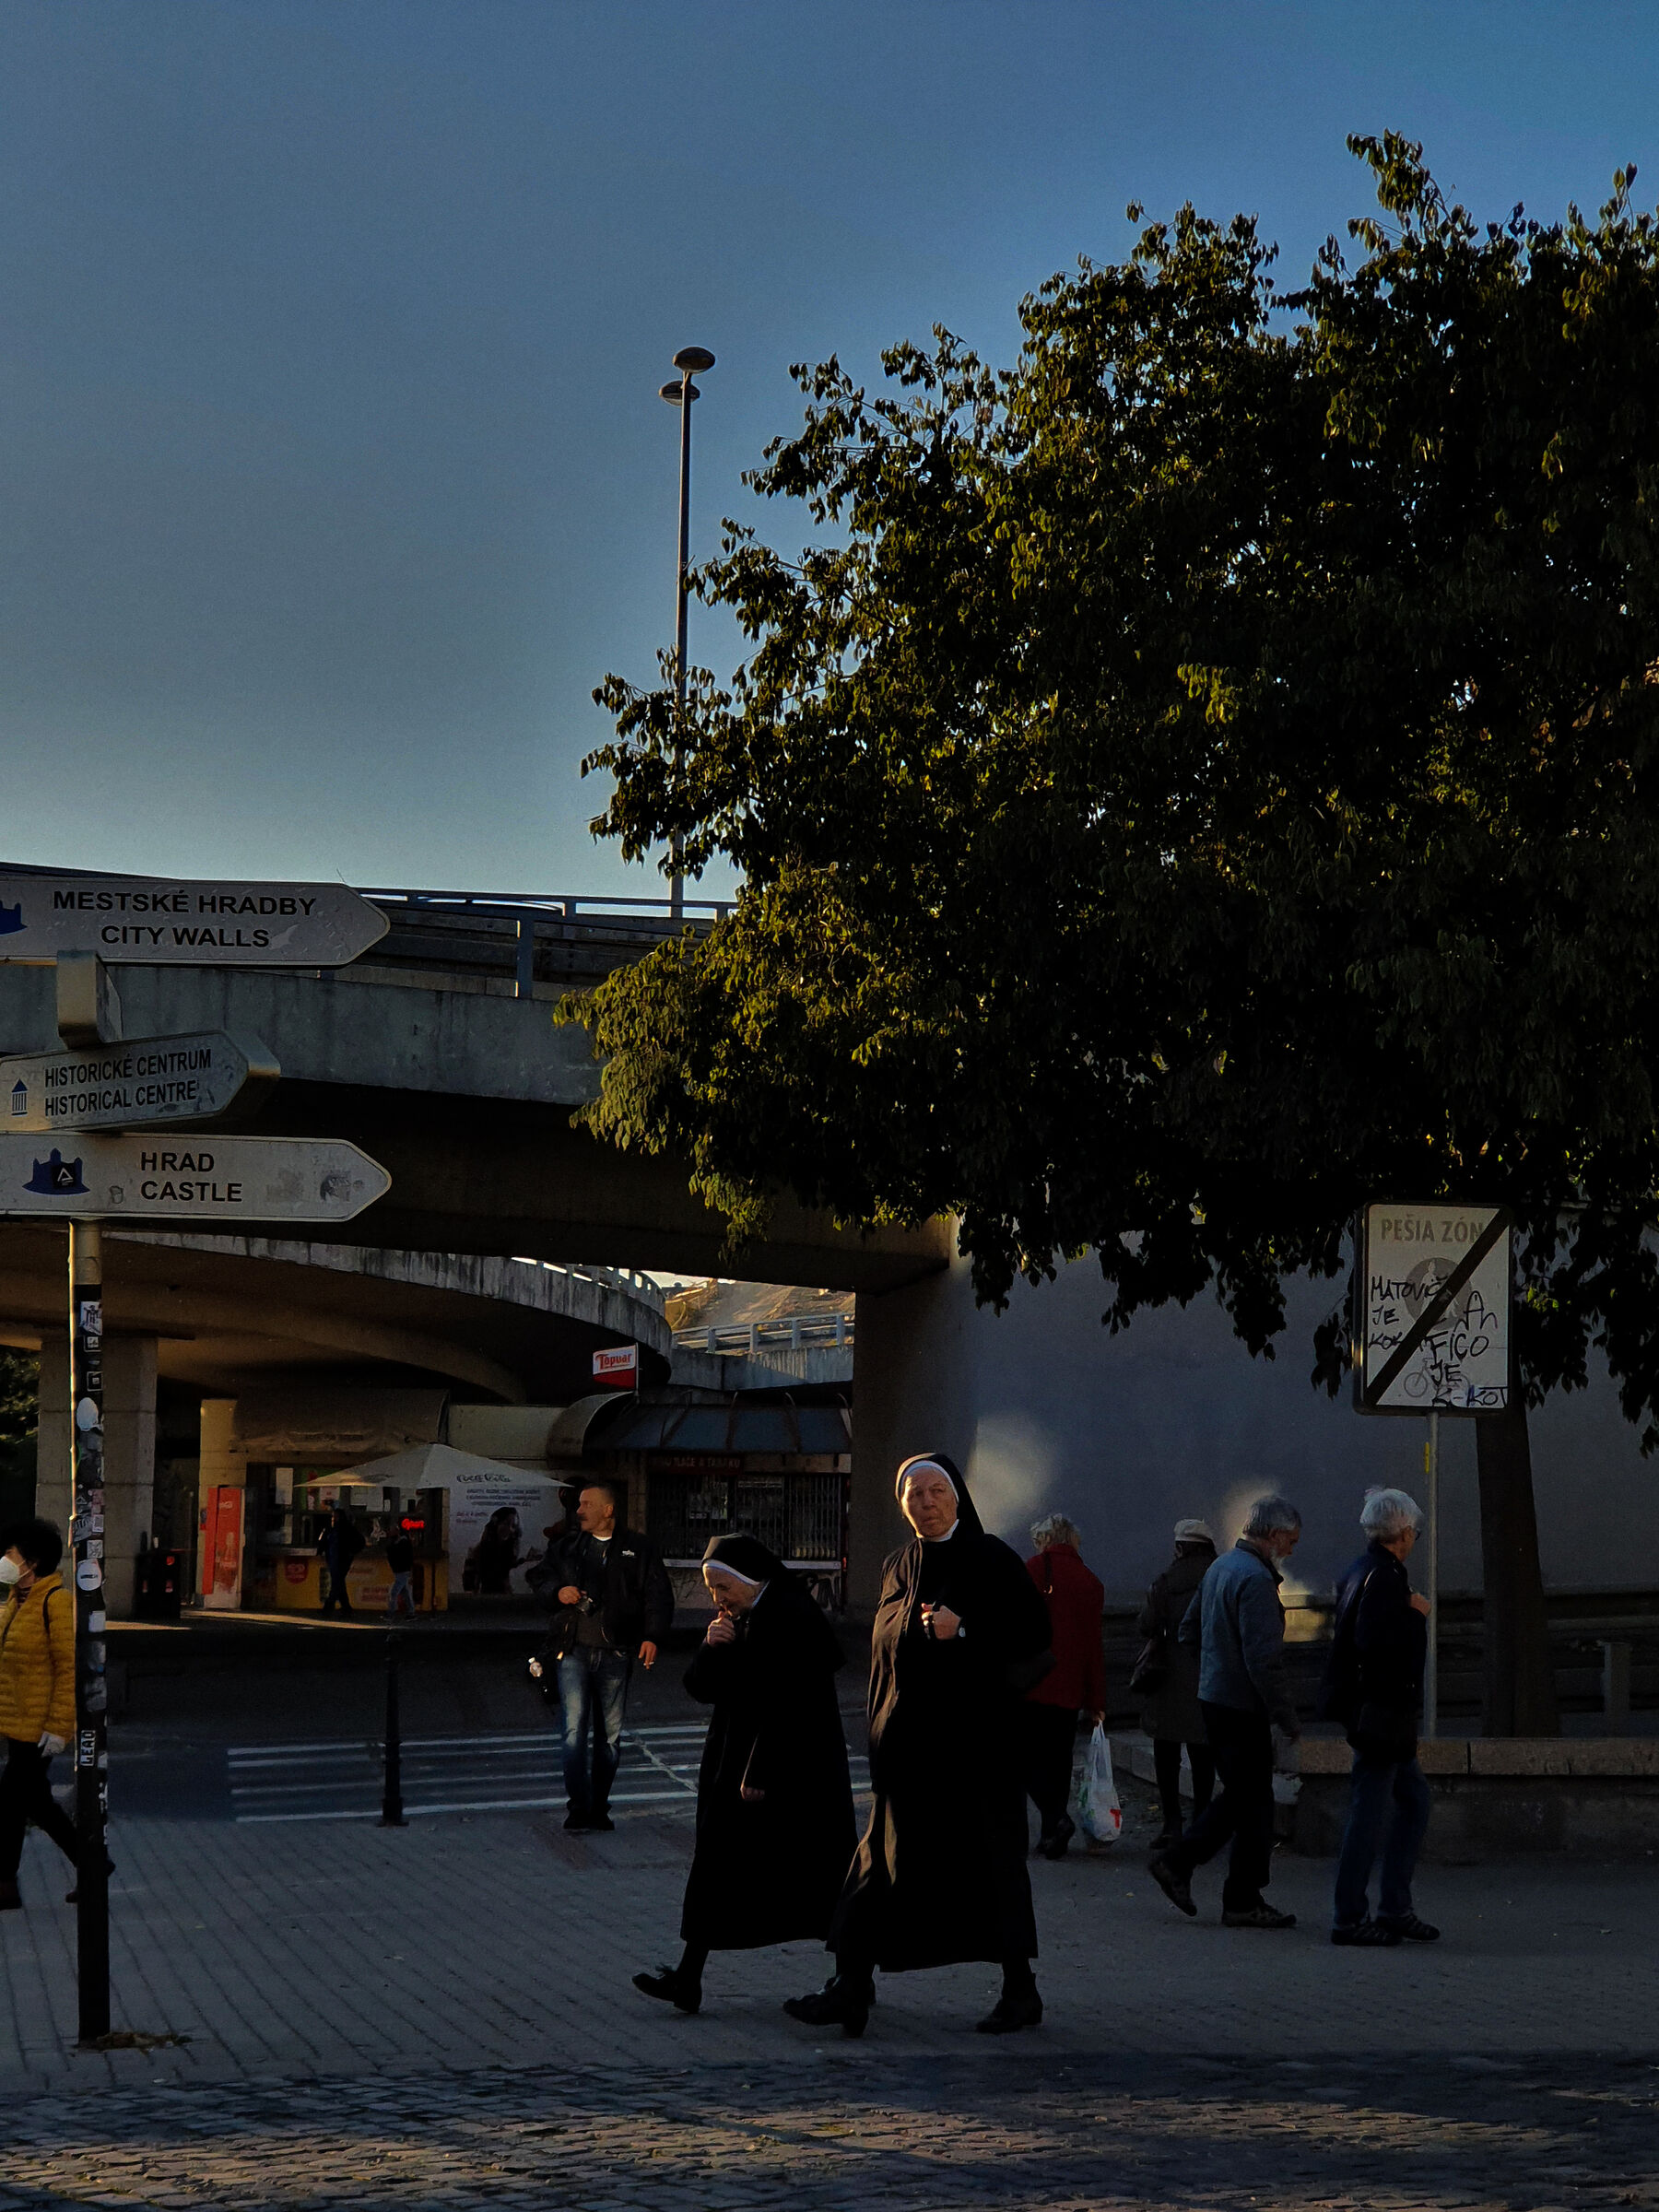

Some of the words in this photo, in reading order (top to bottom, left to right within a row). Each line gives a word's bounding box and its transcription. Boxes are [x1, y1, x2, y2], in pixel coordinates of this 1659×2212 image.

[53, 890, 190, 913] MESTSKÉ
[197, 893, 317, 916] HRADBY
[100, 925, 164, 945] CITY
[172, 927, 270, 947] WALLS
[44, 1053, 133, 1088] HISTORICKÉ
[136, 1048, 212, 1076] CENTRUM
[44, 1085, 133, 1116] HISTORICAL
[135, 1079, 197, 1104] CENTRE
[140, 1152, 215, 1172] HRAD
[140, 1182, 242, 1202] CASTLE
[1381, 1213, 1435, 1242] PEŠIA
[1441, 1216, 1486, 1243] ZÓN
[1371, 1305, 1399, 1325] JE
[1425, 1330, 1489, 1365] FICO
[1430, 1359, 1463, 1386] JE
